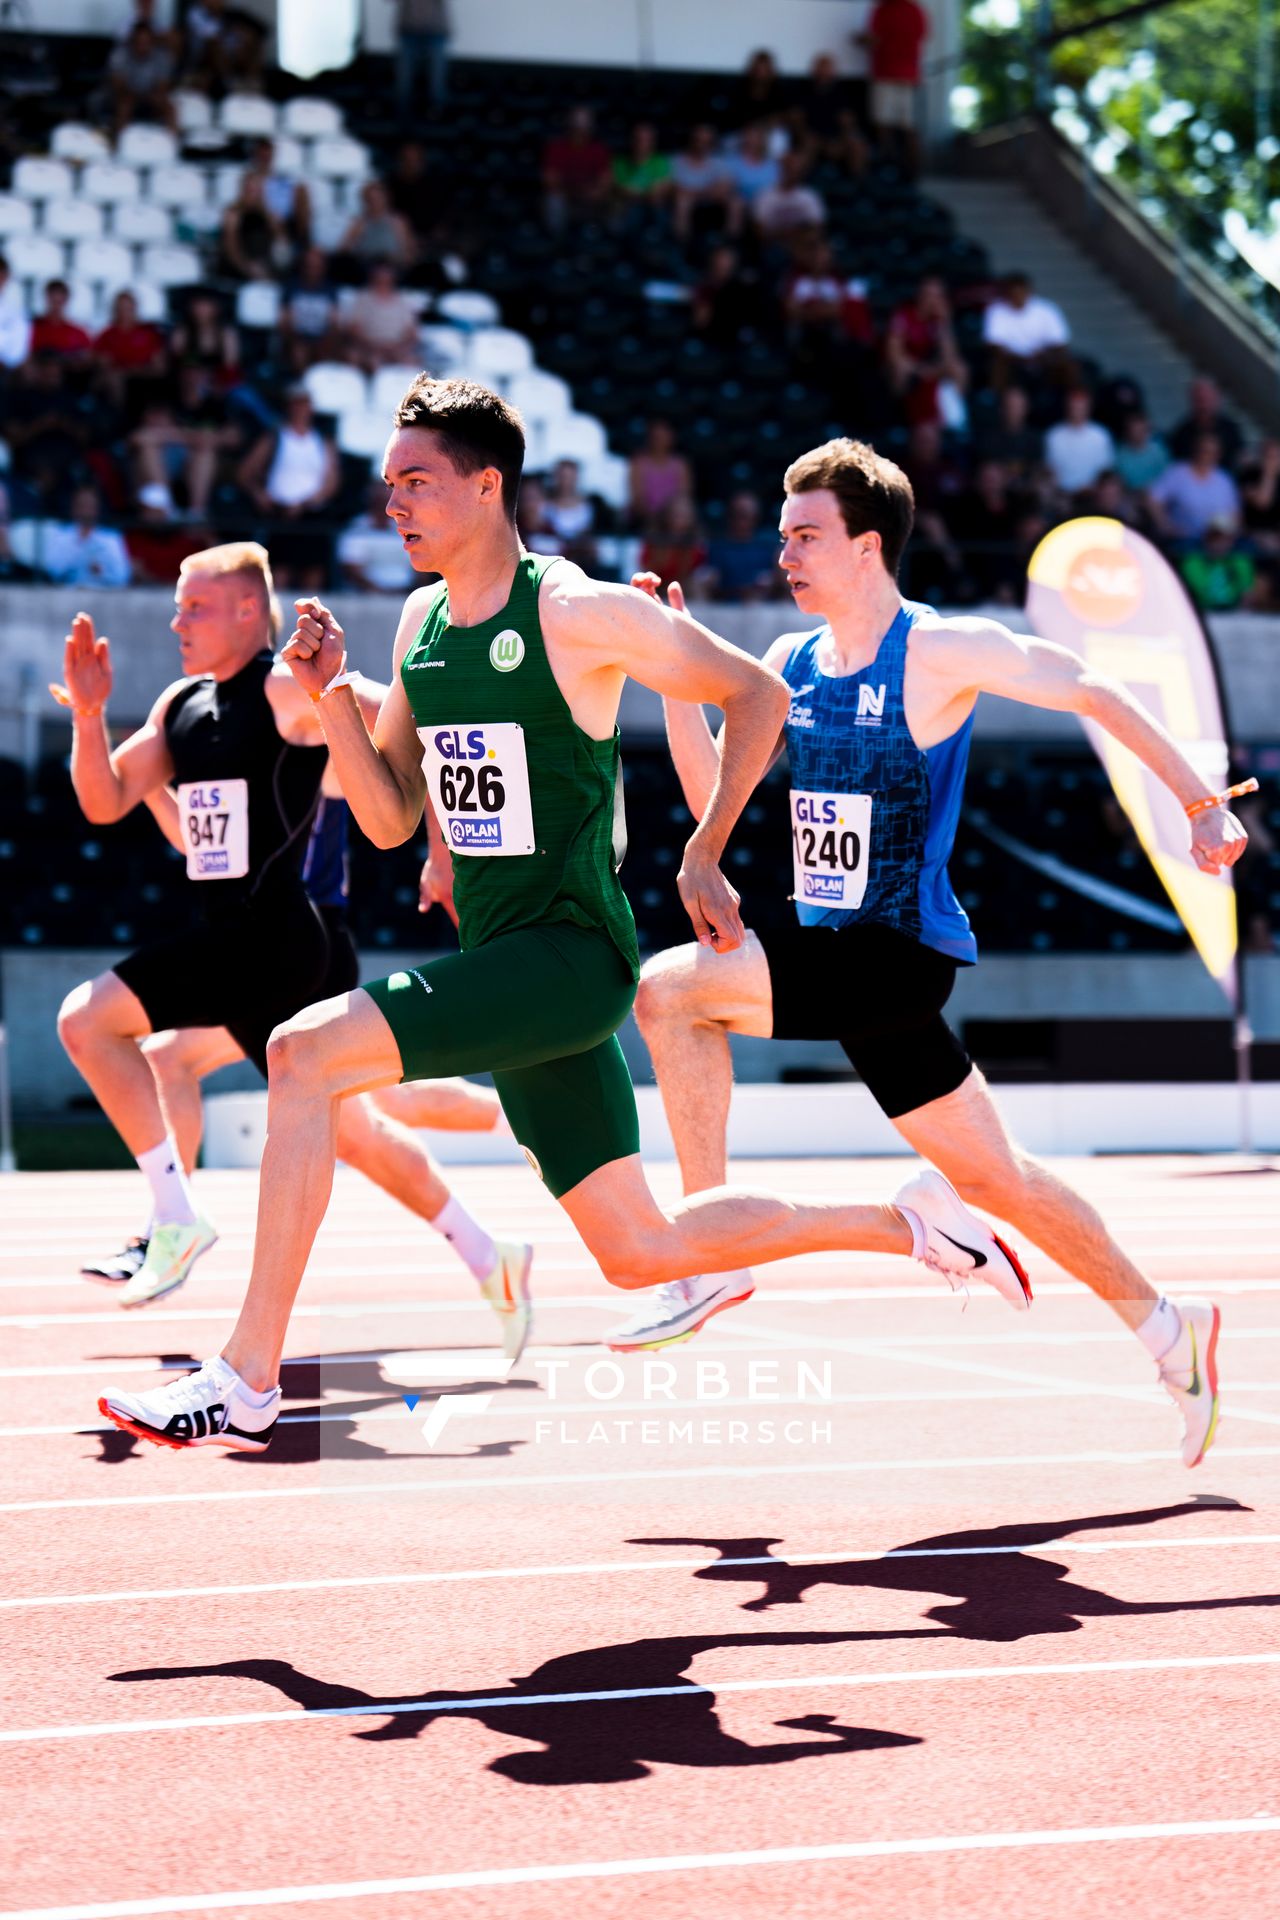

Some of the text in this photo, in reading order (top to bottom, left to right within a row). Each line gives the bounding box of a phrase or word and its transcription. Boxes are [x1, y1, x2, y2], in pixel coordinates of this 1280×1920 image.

[440, 764, 506, 813] 626
[188, 813, 230, 847] 847
[465, 823, 498, 837] PLAN
[815, 877, 843, 892] PLAN
